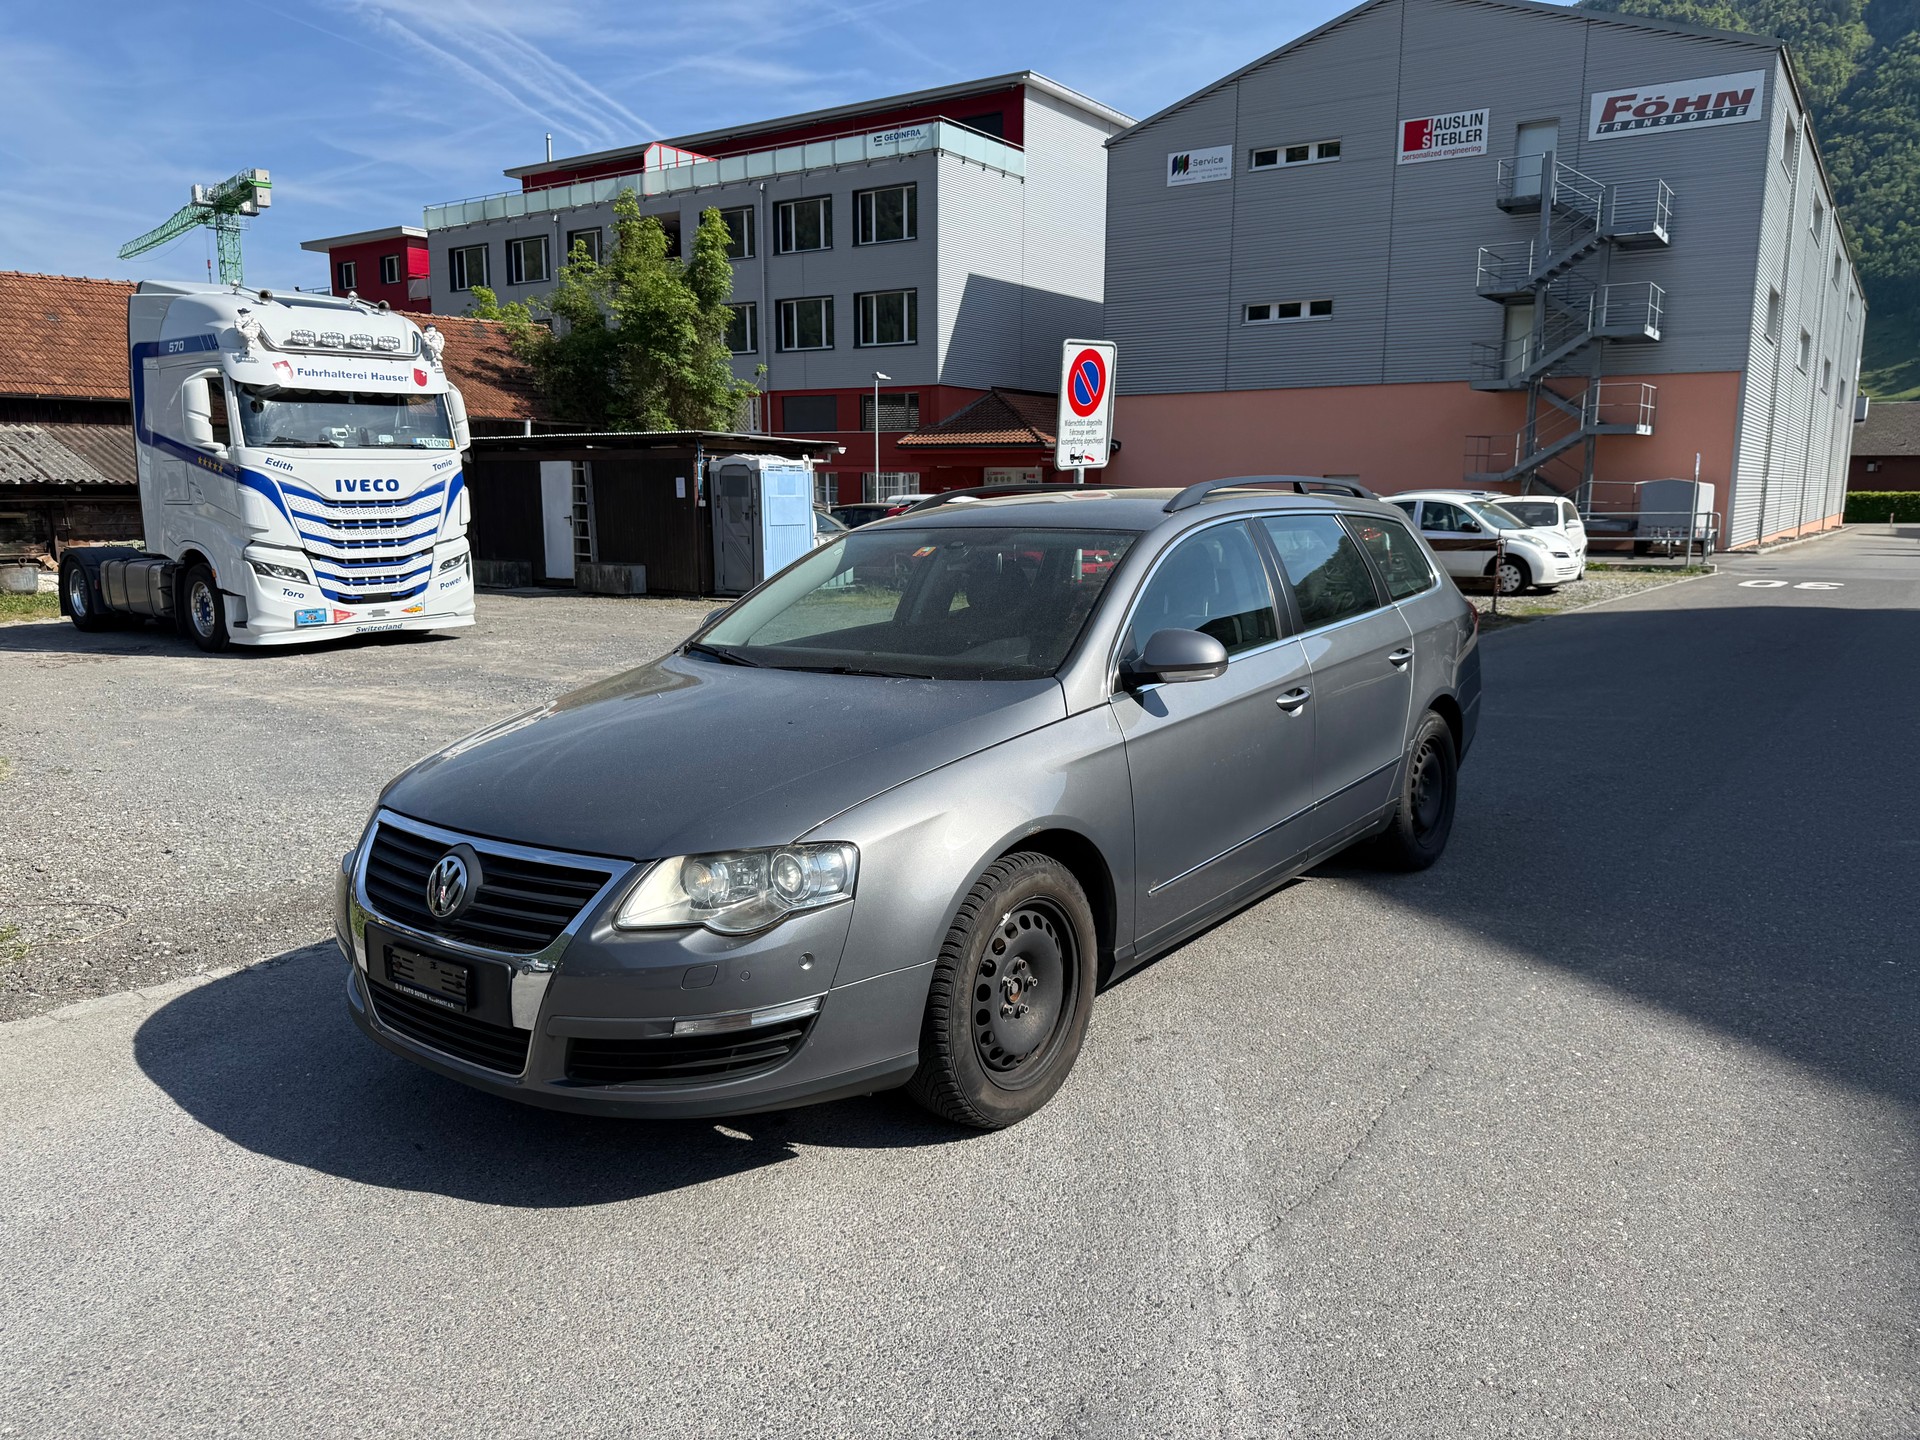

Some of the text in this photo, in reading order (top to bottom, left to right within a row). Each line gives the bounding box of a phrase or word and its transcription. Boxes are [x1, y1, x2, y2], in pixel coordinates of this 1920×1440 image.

[1601, 88, 1755, 122] FÖHN
[1424, 113, 1483, 133] JAUSLIN
[1599, 107, 1744, 132] TRANSPORTE
[884, 129, 921, 141] GEOINFRA
[1422, 129, 1482, 149] STEBLER
[1402, 146, 1482, 161] personalized engineering
[169, 341, 184, 353] 570
[297, 368, 409, 382] Fuhrhalterei Hauser
[419, 438, 450, 448] ANTONIO
[265, 457, 294, 472] Edith
[432, 459, 453, 472] Tonio
[335, 479, 400, 493] IVECO
[439, 576, 462, 591] Power
[282, 588, 305, 600] Toro
[355, 623, 403, 633] Switzerland
[403, 986, 414, 994] AUTO
